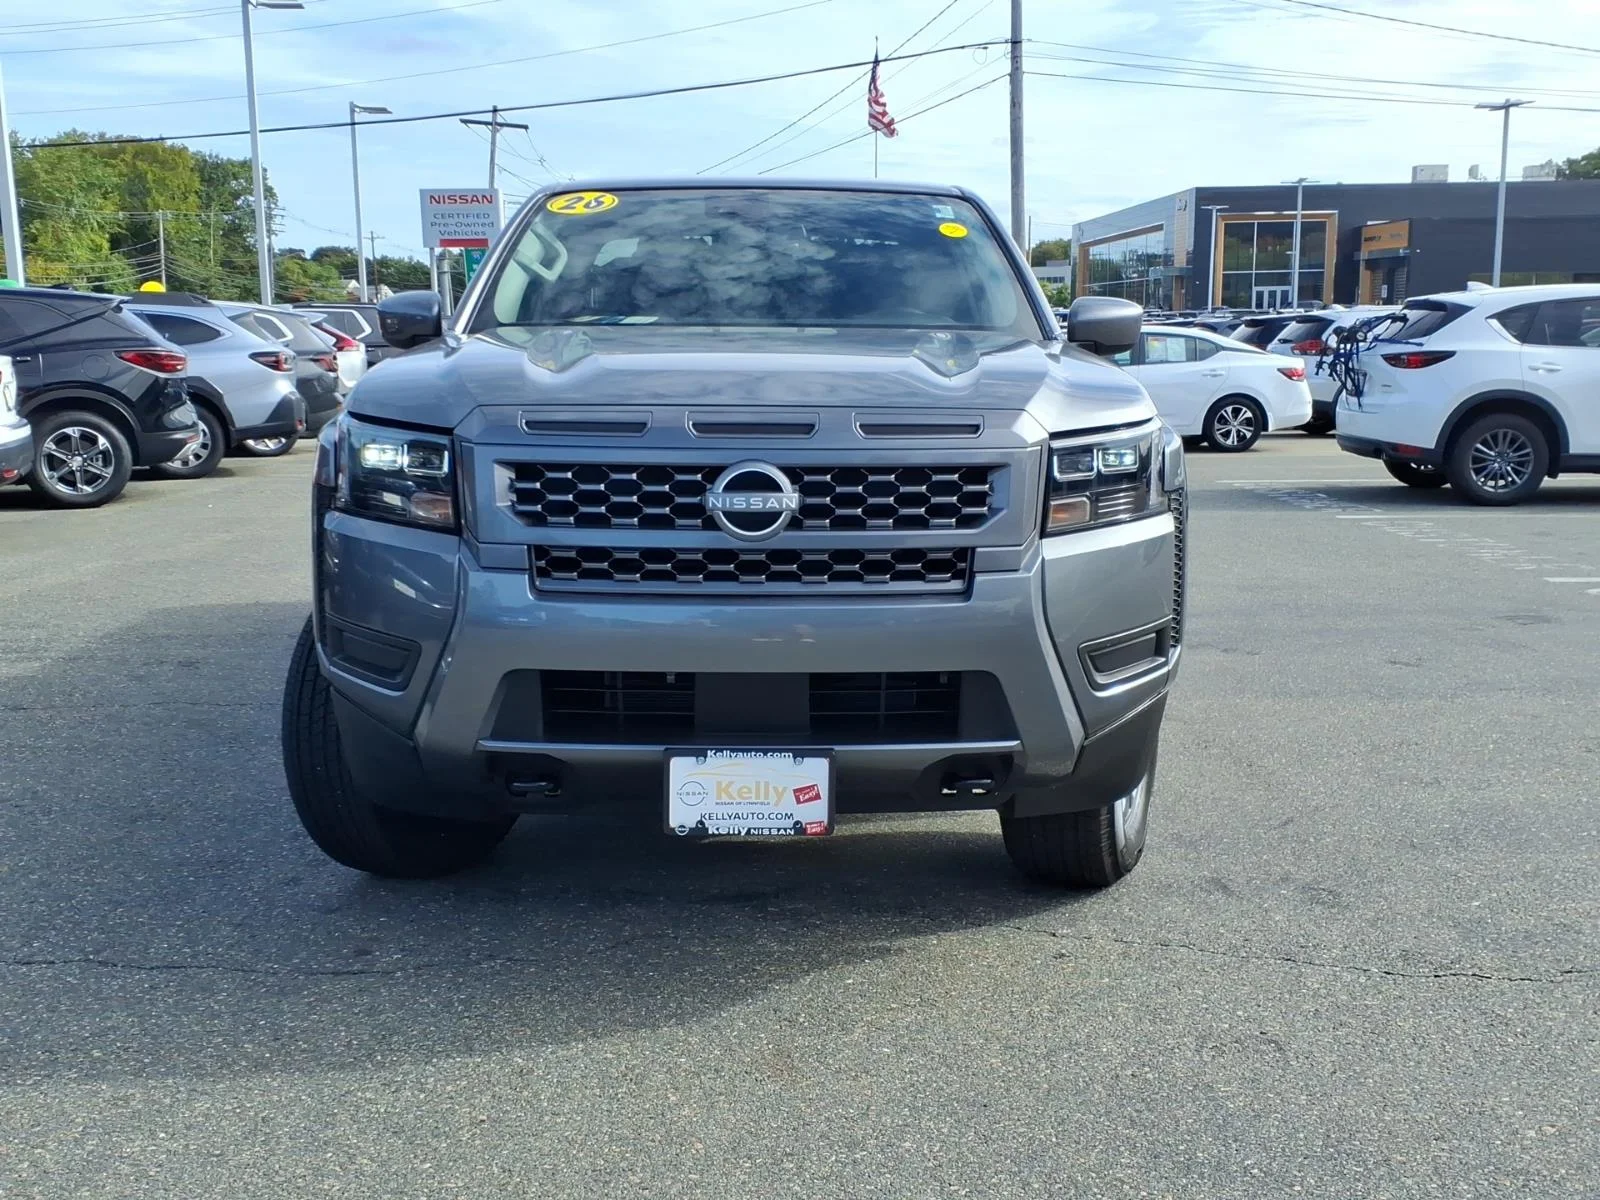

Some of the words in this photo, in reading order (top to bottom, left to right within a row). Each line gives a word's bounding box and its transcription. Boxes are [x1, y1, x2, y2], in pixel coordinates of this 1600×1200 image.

[429, 194, 493, 205] NISSAN
[433, 212, 490, 220] CERTIFIED
[708, 496, 796, 509] NISSAN
[706, 749, 793, 760] Kellyauto.com
[715, 780, 788, 807] Kelly
[700, 812, 794, 820] KELLYAUTO.COM
[707, 824, 748, 836] Kelly
